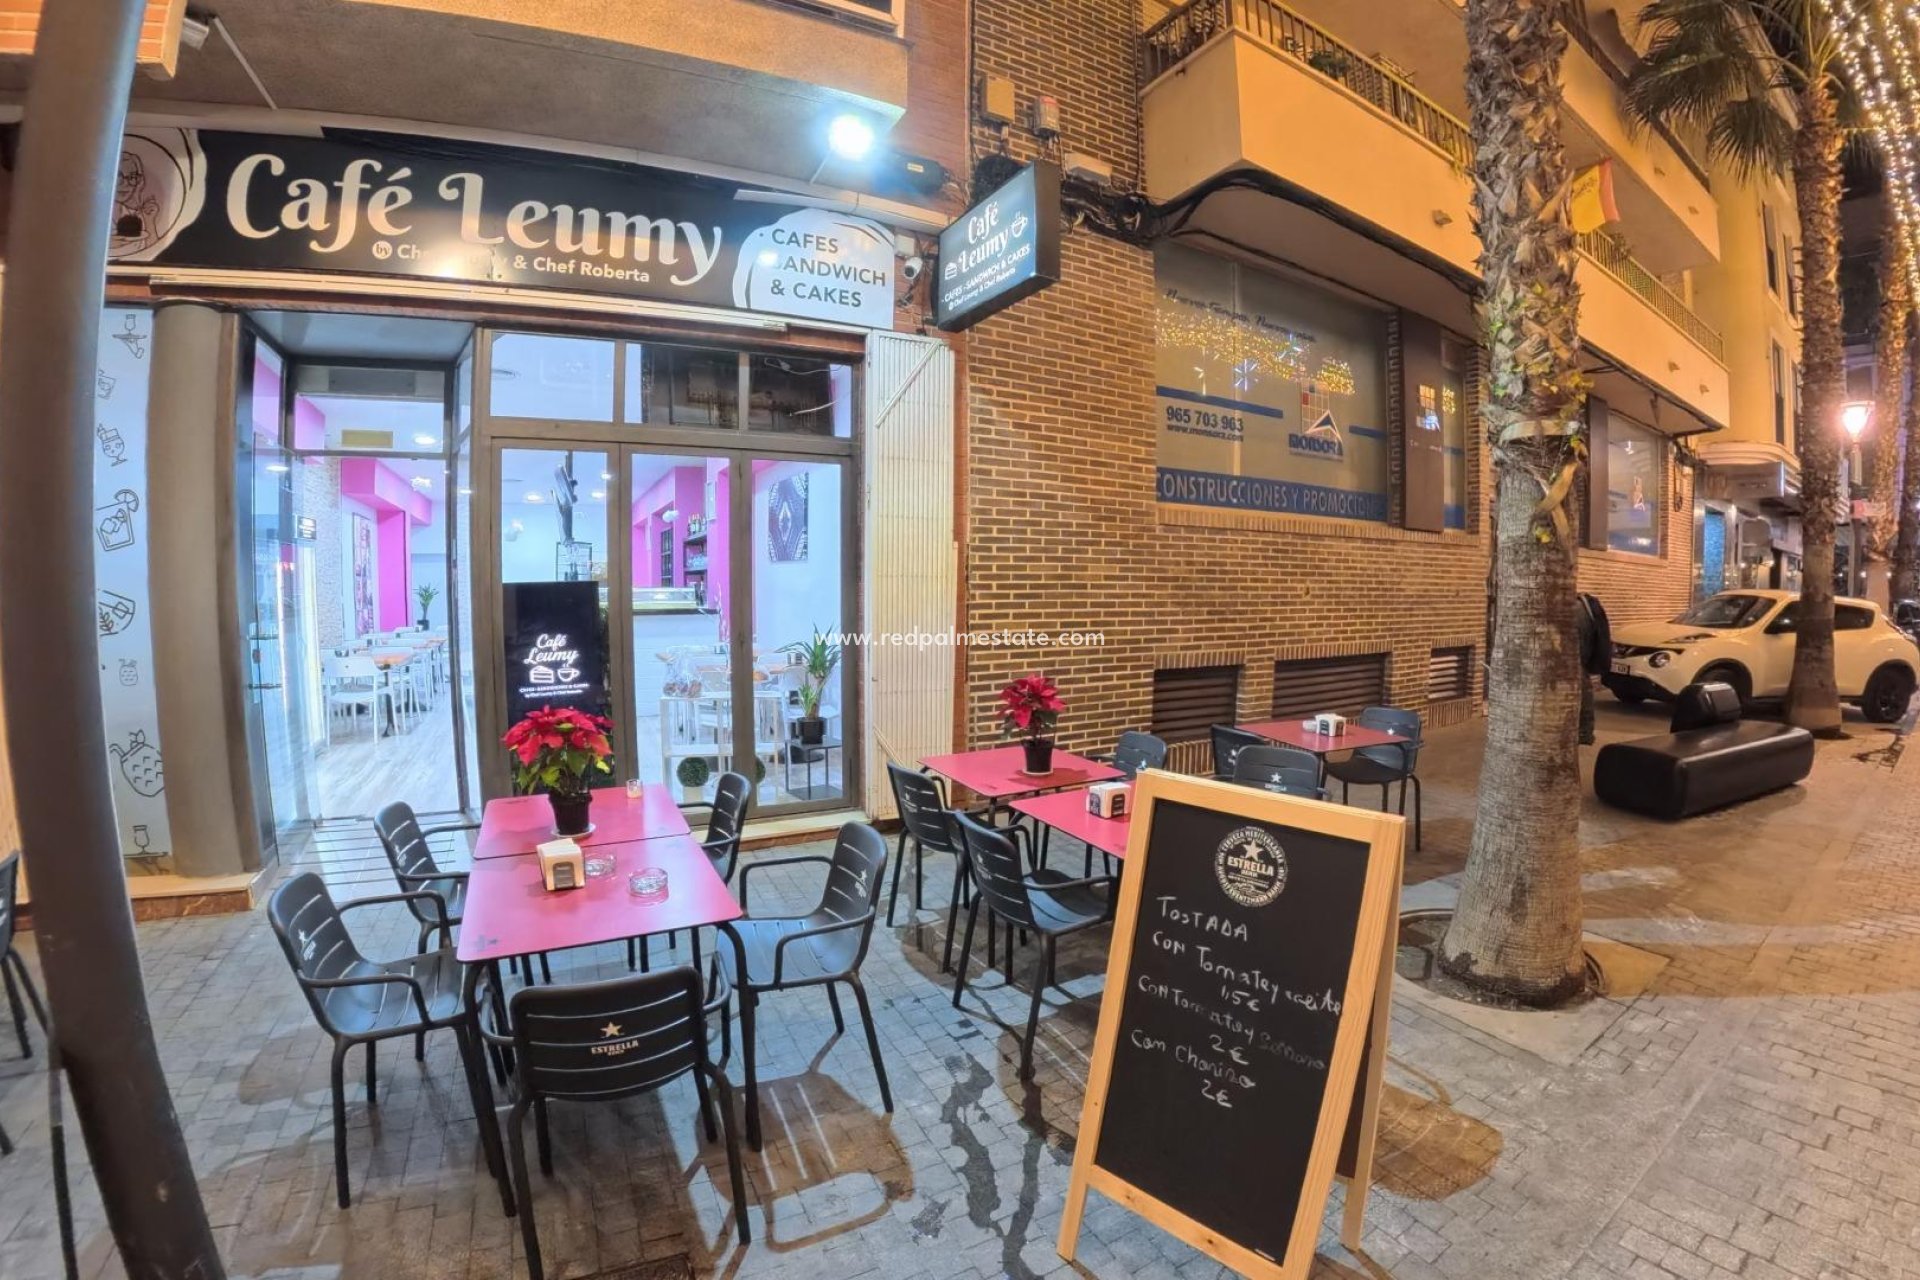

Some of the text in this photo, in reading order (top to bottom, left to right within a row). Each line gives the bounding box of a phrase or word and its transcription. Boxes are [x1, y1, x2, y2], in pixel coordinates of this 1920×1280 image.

[227, 154, 722, 287] Café Leumy
[771, 228, 839, 255] CAFES
[958, 202, 1009, 273] Café Leumy
[513, 255, 527, 269] &
[533, 256, 575, 275] Chef
[580, 261, 650, 283] Roberta
[774, 254, 886, 288] ANDWICH
[770, 279, 862, 308] & CAKES
[1167, 406, 1191, 424] 965
[1195, 410, 1218, 428] 703
[1292, 489, 1299, 508] Y
[536, 633, 567, 651] Café
[523, 647, 580, 666] Leumy
[1227, 856, 1274, 877] ESTRELLA
[591, 1039, 639, 1055] ESTRELLA
